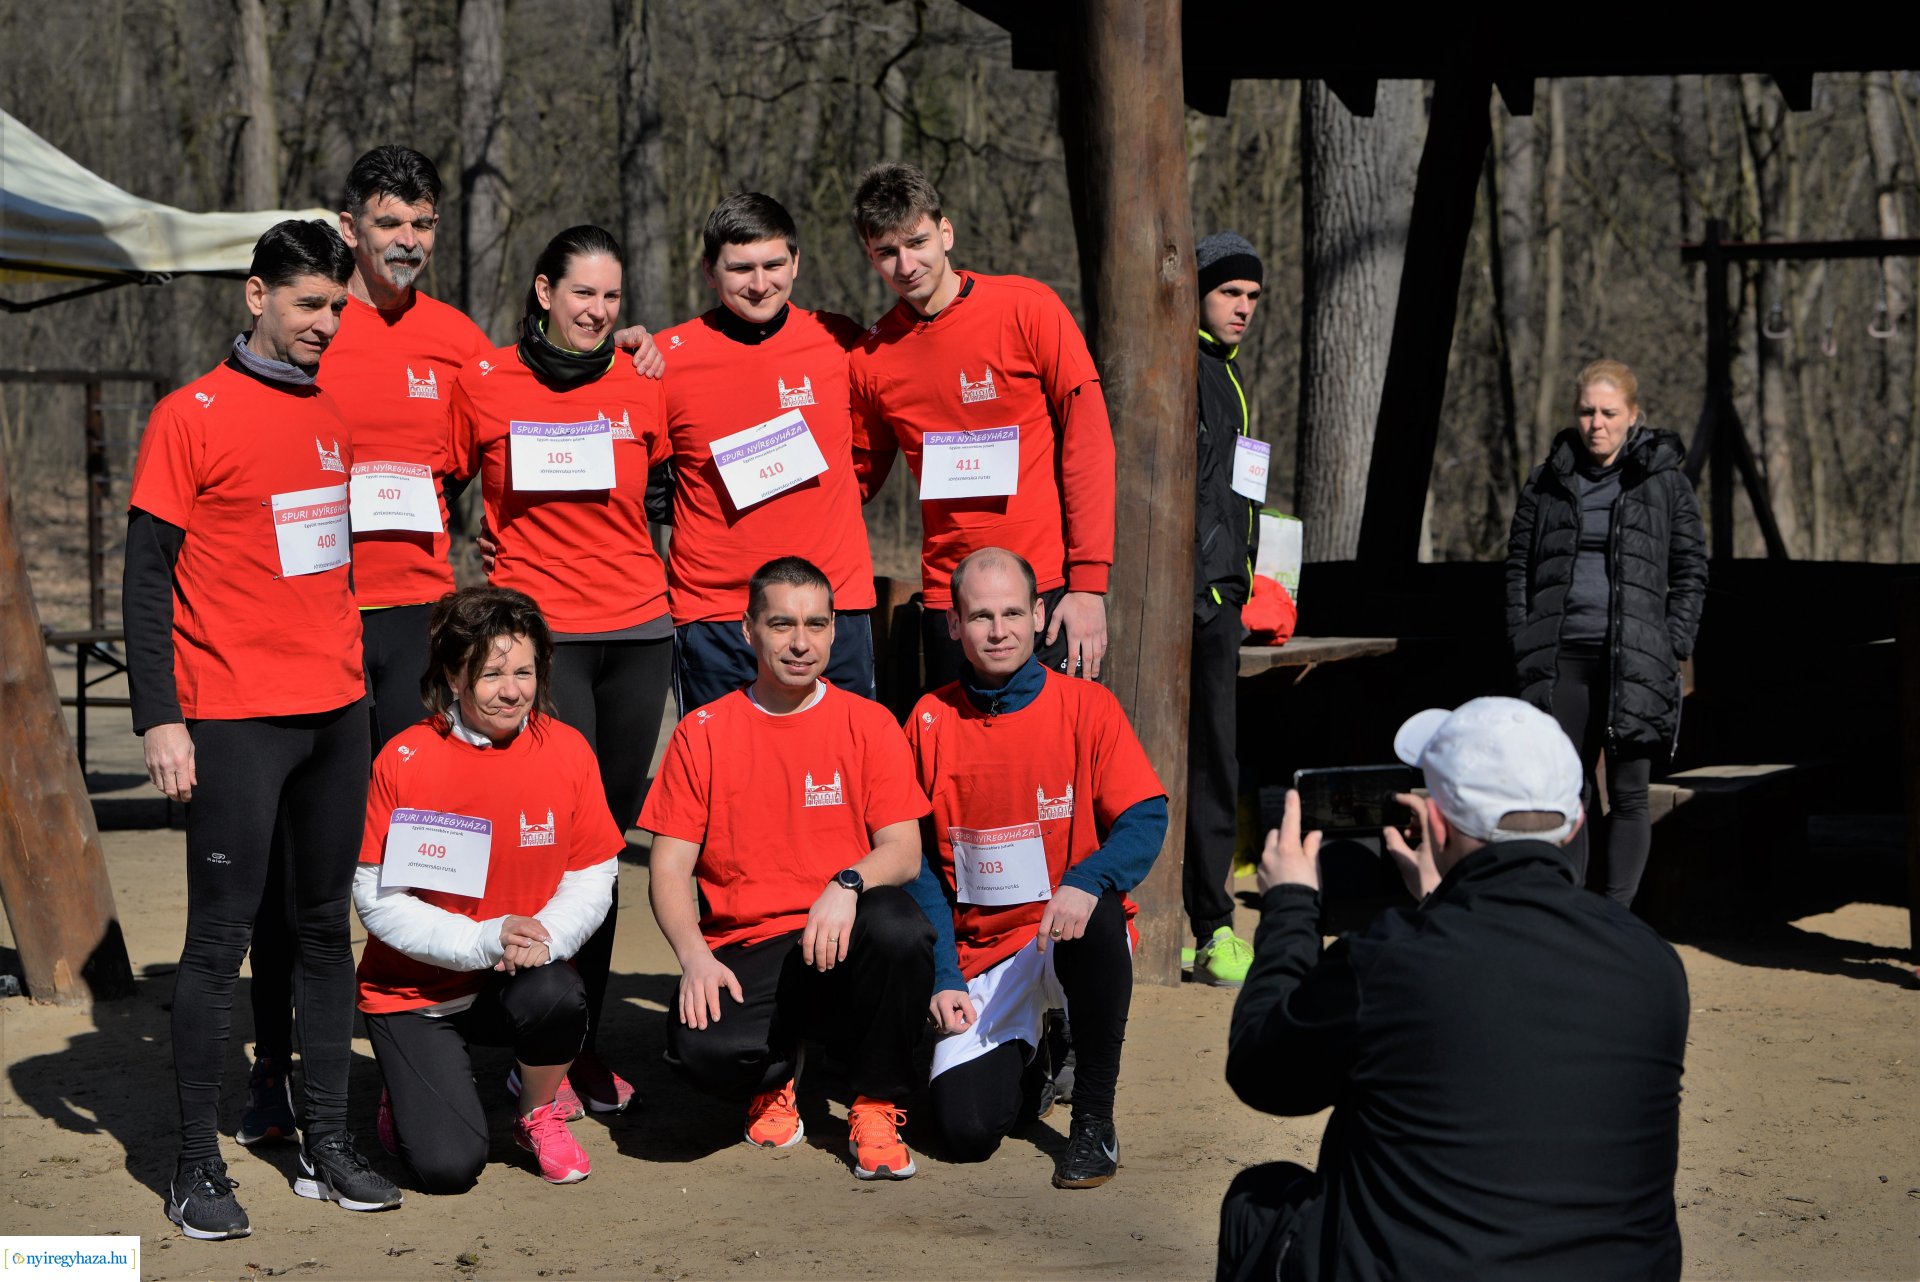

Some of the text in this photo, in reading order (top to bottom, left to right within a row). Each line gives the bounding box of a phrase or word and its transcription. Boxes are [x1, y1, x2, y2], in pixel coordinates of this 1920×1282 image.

[517, 423, 606, 435] SPURI NYÍREGYHÁZA
[929, 430, 1014, 444] SPURI NYÍREGYHÁZA
[721, 449, 745, 465] SPURI
[747, 425, 803, 456] NYÍREGYHÁZA
[547, 452, 573, 464] 105
[956, 458, 980, 471] 411
[759, 462, 784, 480] 410
[377, 488, 401, 500] 407
[281, 510, 309, 522] SPURI
[317, 533, 337, 549] 408
[394, 812, 488, 832] SPURI NYÍREGYHÁZA
[974, 828, 1036, 844] NYÍREGYHÁZA
[418, 842, 447, 859] 409
[978, 861, 1004, 874] 203
